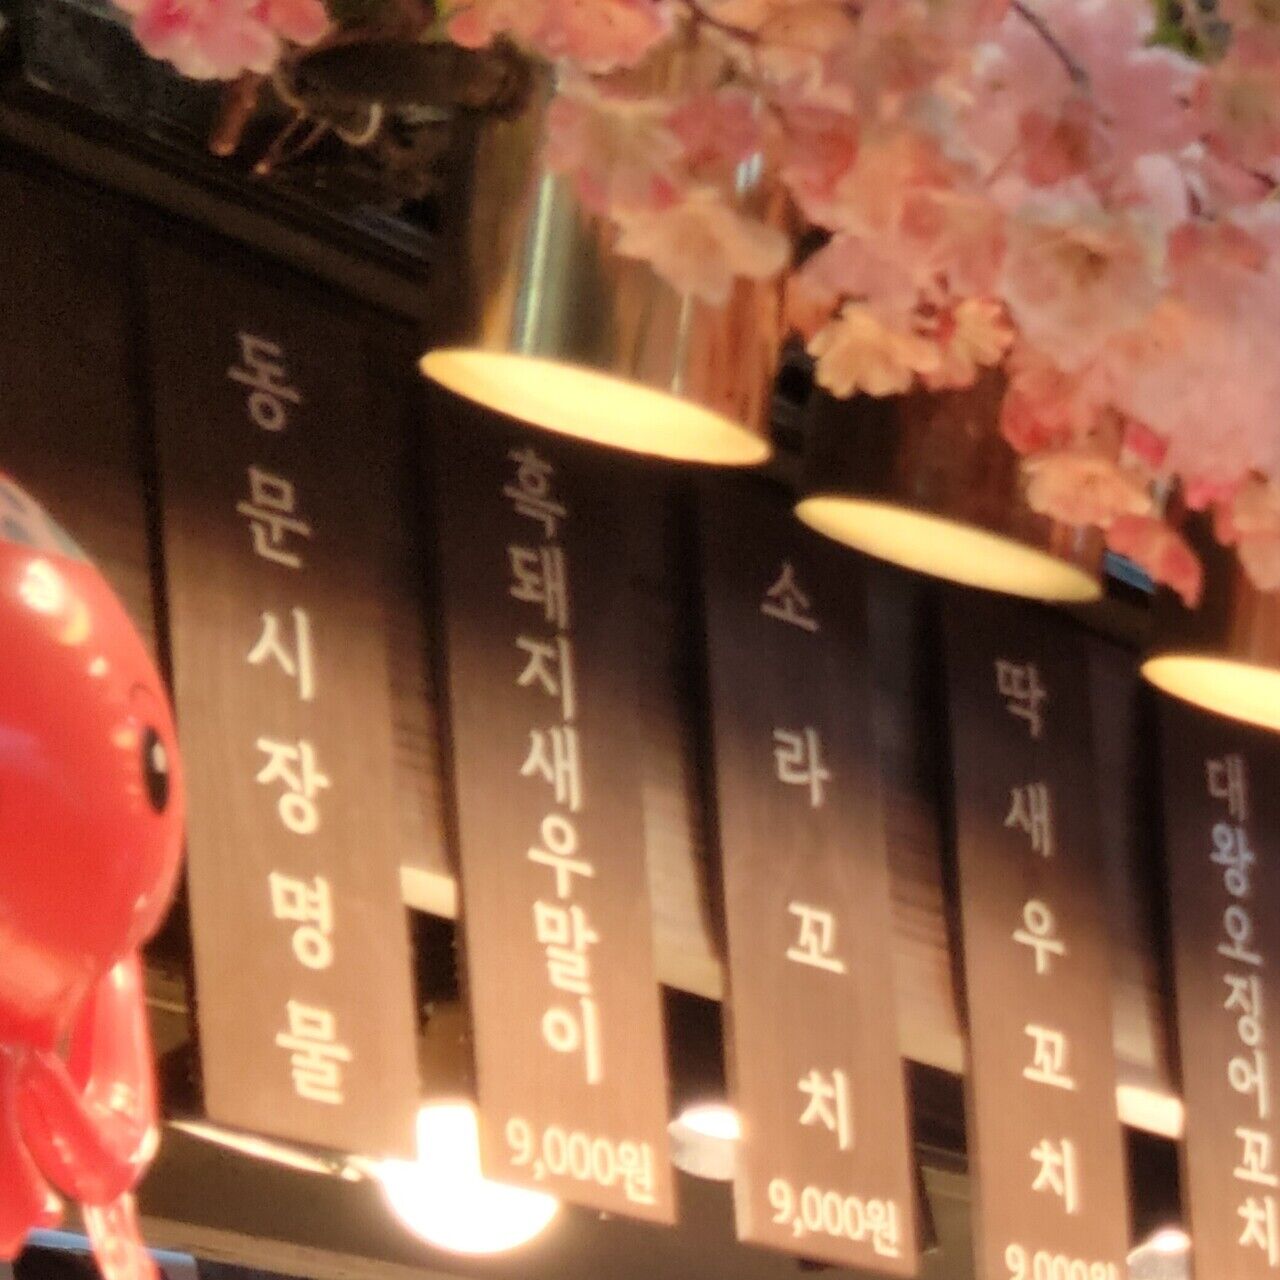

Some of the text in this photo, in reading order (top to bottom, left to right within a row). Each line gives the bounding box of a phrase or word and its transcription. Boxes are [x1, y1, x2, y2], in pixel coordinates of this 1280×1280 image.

[501, 446, 601, 1084] 흑돼지새우말이
[760, 564, 852, 1150] 소라꼬치
[995, 660, 1079, 1214] 딱새우꼬치
[1206, 755, 1280, 1267] 대왕오징어꼬치
[504, 1117, 658, 1204] 9,000원
[767, 1180, 903, 1259] 9,000원
